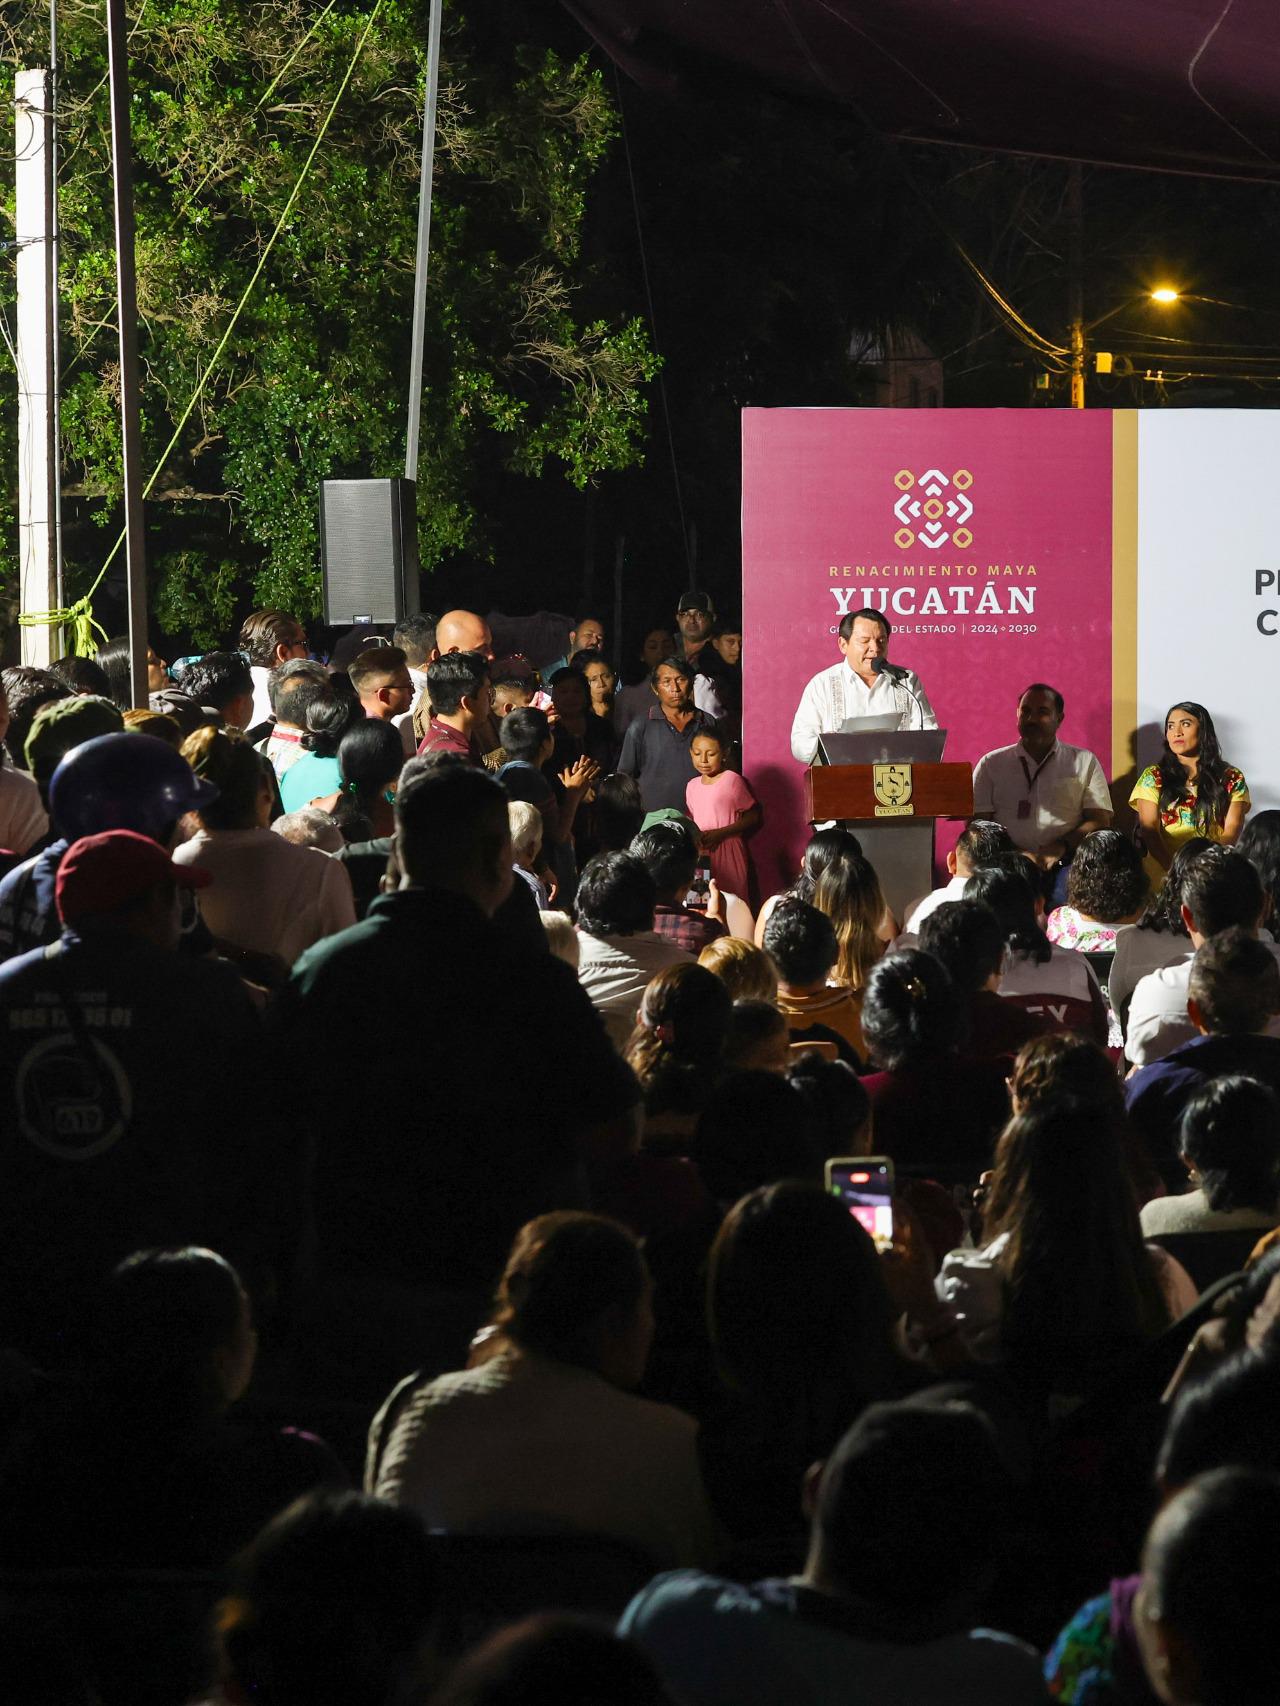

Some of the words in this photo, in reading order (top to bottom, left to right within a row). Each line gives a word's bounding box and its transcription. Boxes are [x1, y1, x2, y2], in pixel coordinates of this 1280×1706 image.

[829, 565, 978, 577] RENACIMIENTO
[987, 565, 1037, 576] MAYA
[829, 581, 1037, 616] YUCATÁN
[891, 625, 912, 634] DEL
[915, 625, 957, 634] ESTADO
[970, 624, 999, 635] 2024
[1008, 624, 1037, 636] 2030
